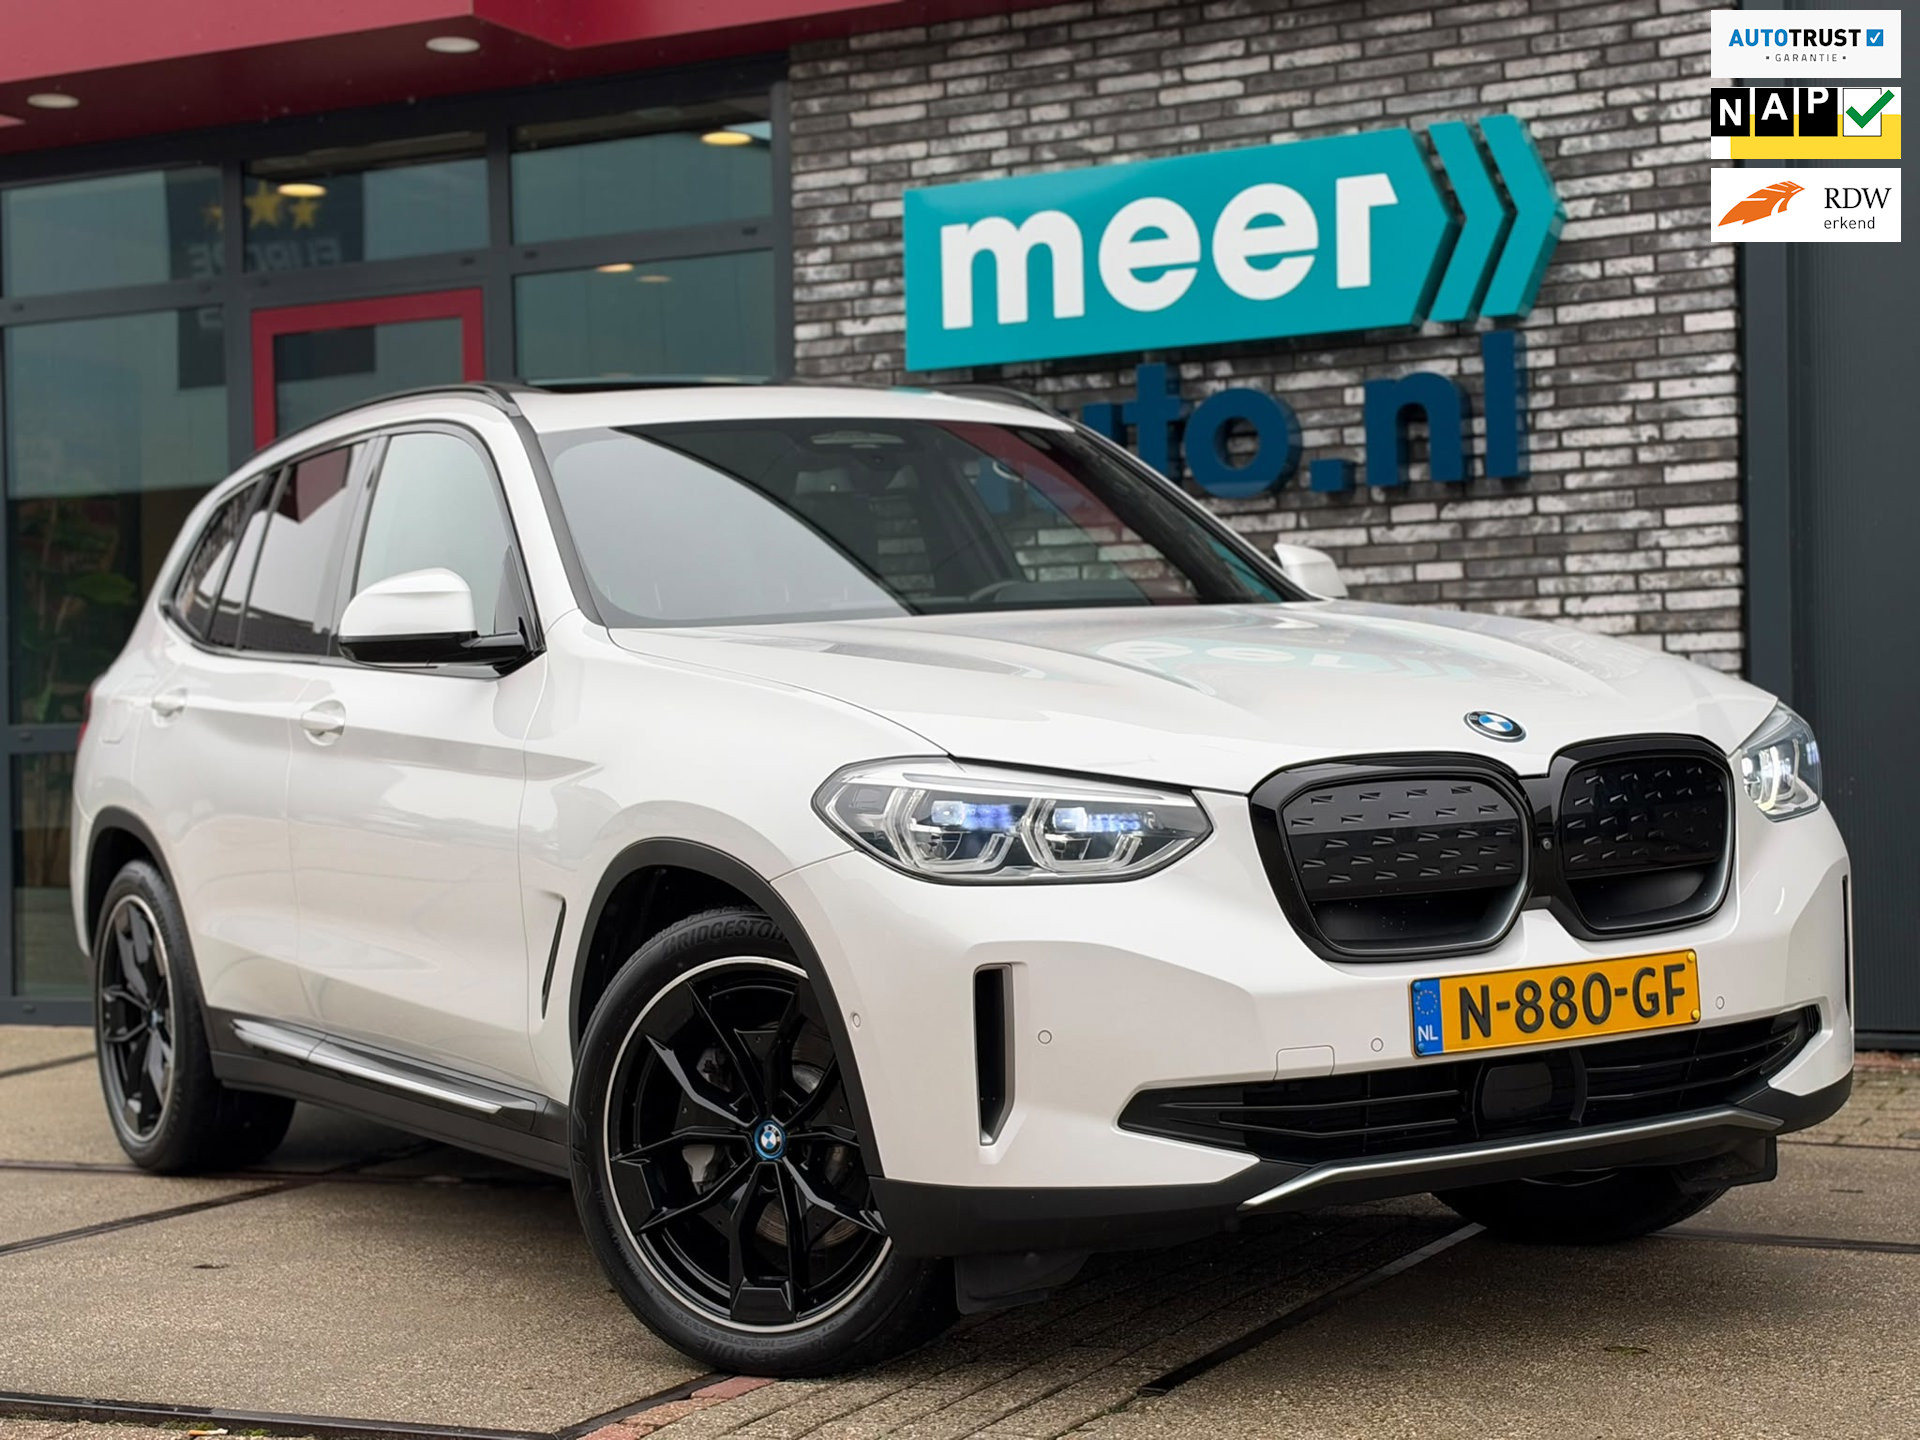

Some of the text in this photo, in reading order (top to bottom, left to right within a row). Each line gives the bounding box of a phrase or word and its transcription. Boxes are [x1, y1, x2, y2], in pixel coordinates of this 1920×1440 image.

[941, 173, 1398, 329] meer
[1418, 1025, 1439, 1041] NL
[1458, 963, 1686, 1040] N-880-GF
